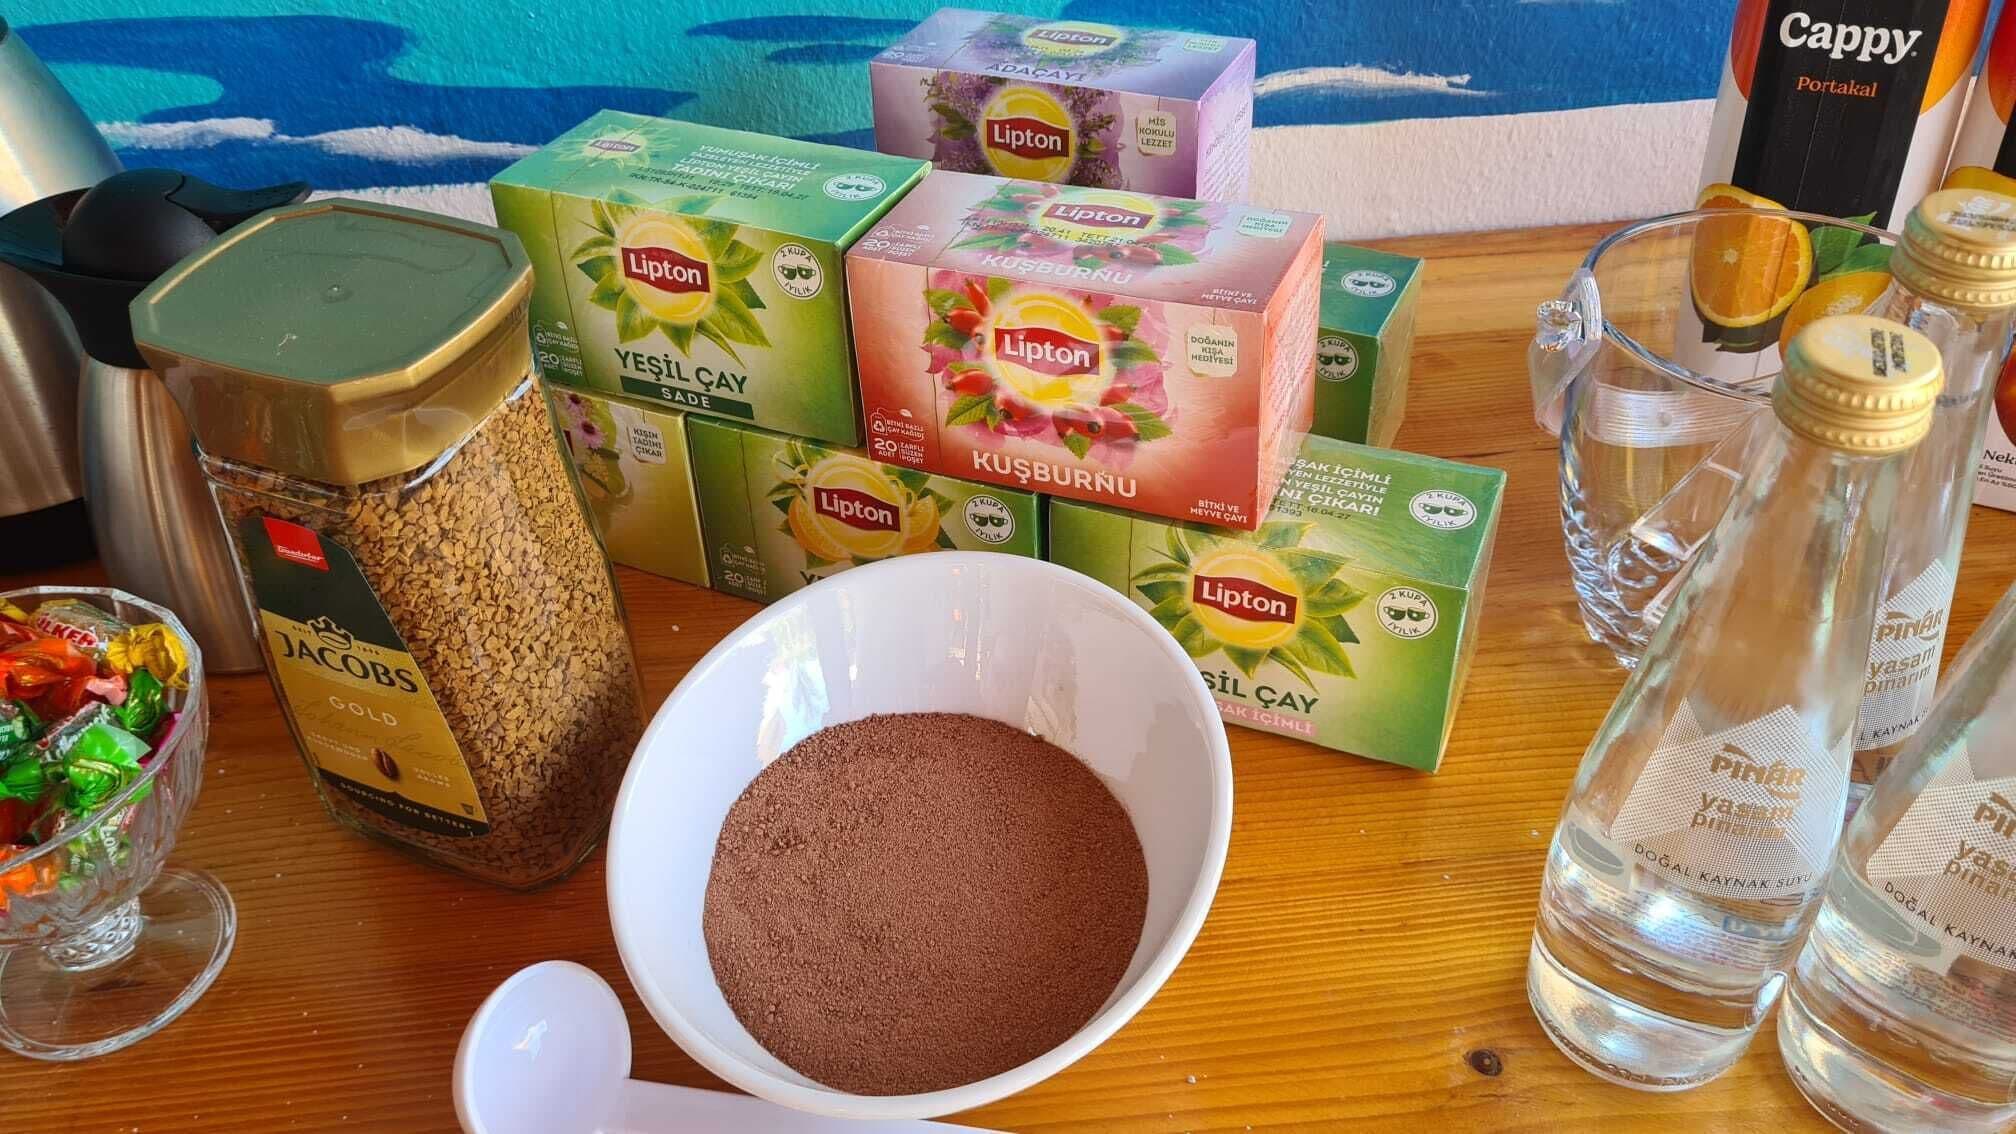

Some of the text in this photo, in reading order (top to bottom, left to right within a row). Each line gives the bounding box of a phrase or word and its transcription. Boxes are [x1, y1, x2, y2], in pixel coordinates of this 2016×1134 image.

[1036, 29, 1109, 46] Lipton
[1780, 12, 1922, 64] Cappy
[985, 63, 1088, 82] ADAÇAYI
[1796, 76, 1878, 97] Portakal
[993, 124, 1063, 152] Lipton
[1054, 205, 1142, 225] Lipton
[787, 247, 812, 262] KUPA
[630, 252, 703, 285] Lipton
[1003, 333, 1091, 368] Lipton
[1190, 334, 1235, 347] DOĞANIN
[614, 348, 690, 383] YEŞİL
[695, 365, 748, 394] ÇAY
[661, 386, 712, 410] SADE
[874, 437, 898, 452] 20
[1983, 449, 2016, 465] Nek
[1333, 464, 1393, 485] İÇİMLİ
[1295, 481, 1334, 493] YEŞİL
[1336, 489, 1385, 504] ÇAYIN
[1436, 493, 1466, 506] KUPA
[821, 492, 894, 527] Lipton
[979, 498, 1004, 512] KUPA
[1190, 507, 1249, 524] MEYVE ÇAYI
[1197, 499, 1240, 514] BİTKİ VE
[1201, 579, 1289, 617] Lipton
[1398, 590, 1428, 606] KUPA
[275, 630, 418, 693] JACOBS
[1255, 685, 1319, 714] ÇAY
[328, 696, 398, 726] GOLD
[1635, 843, 1813, 889] DOĞAL KAYNAK SUYU
[1884, 880, 1937, 927] DOĞAL
